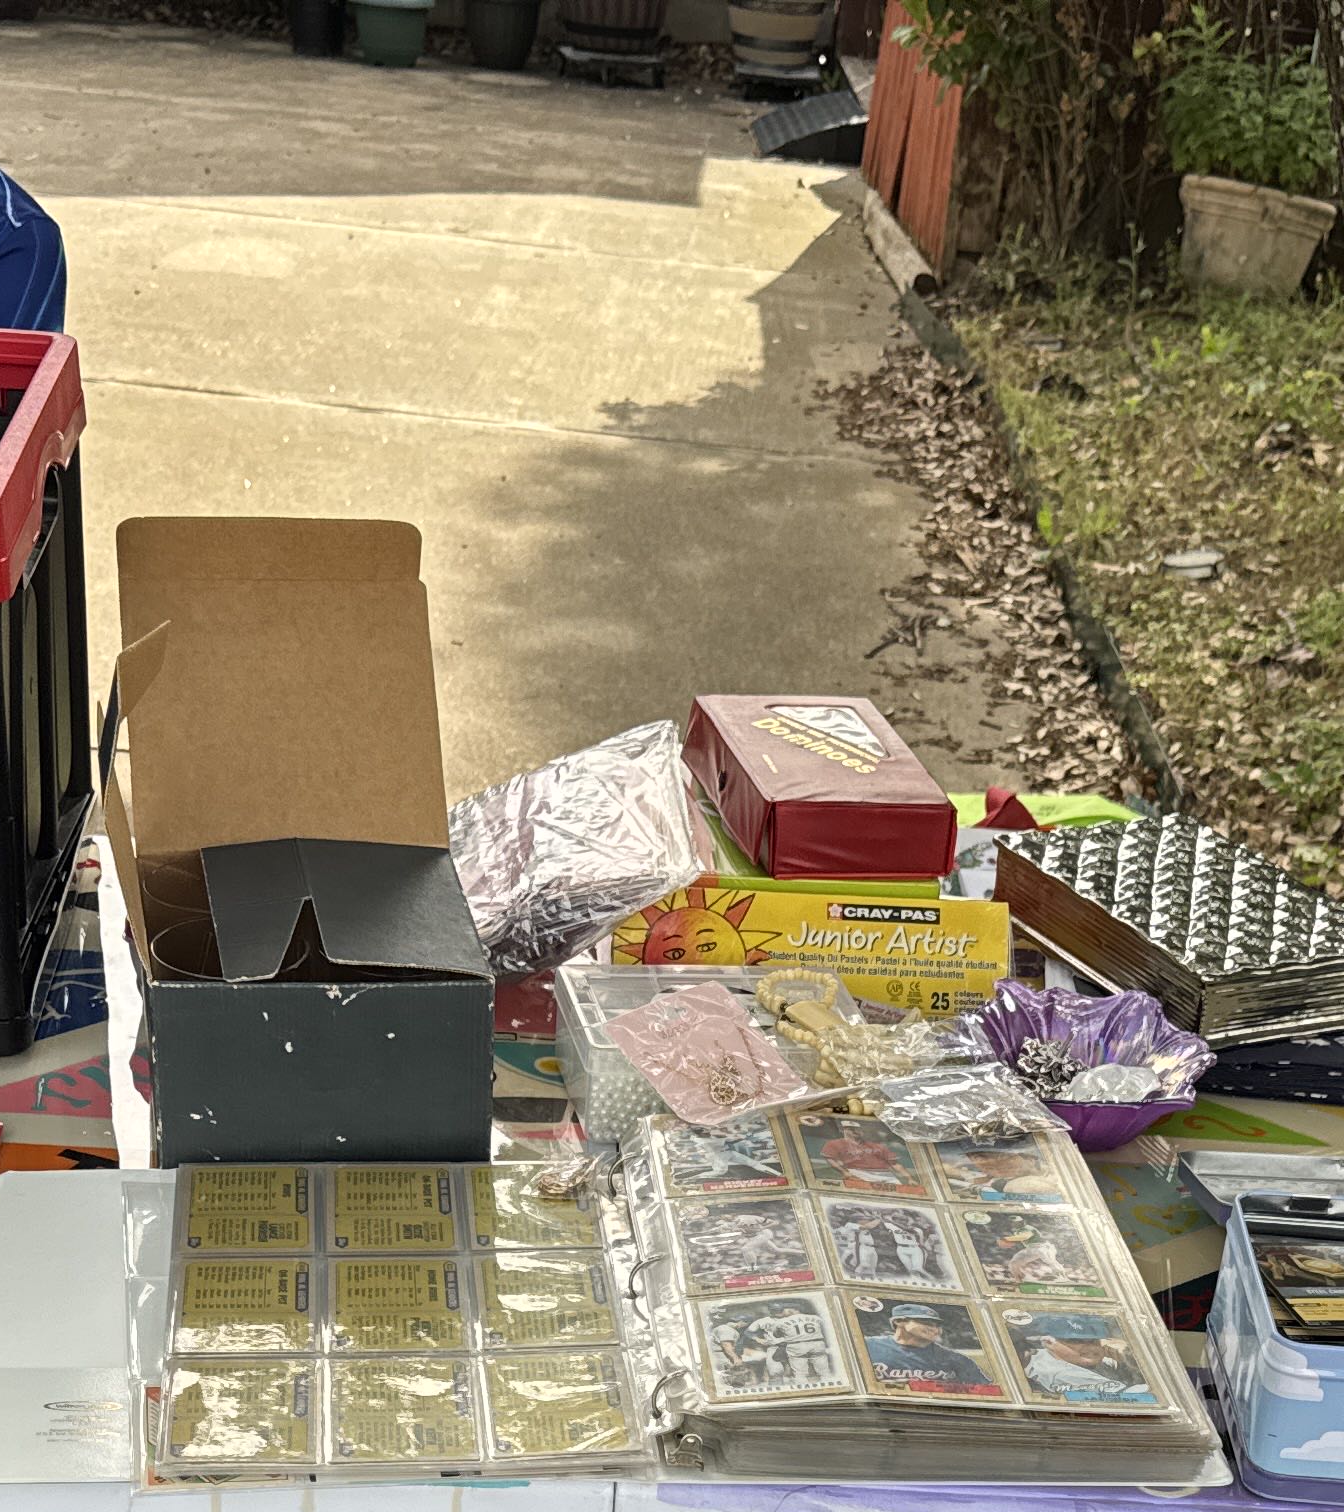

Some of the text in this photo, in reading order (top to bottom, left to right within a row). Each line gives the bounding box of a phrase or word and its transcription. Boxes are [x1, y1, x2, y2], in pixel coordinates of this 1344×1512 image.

[750, 716, 877, 775] Dominoes
[842, 906, 939, 923] CRAY-PAS
[786, 921, 978, 958] Junior Artist
[798, 951, 825, 964] Quality
[840, 954, 869, 965] Pastels
[875, 955, 901, 967] Pastel
[930, 991, 950, 1011] 25
[793, 1322, 816, 1336] 16
[789, 1380, 843, 1391] LEADERS
